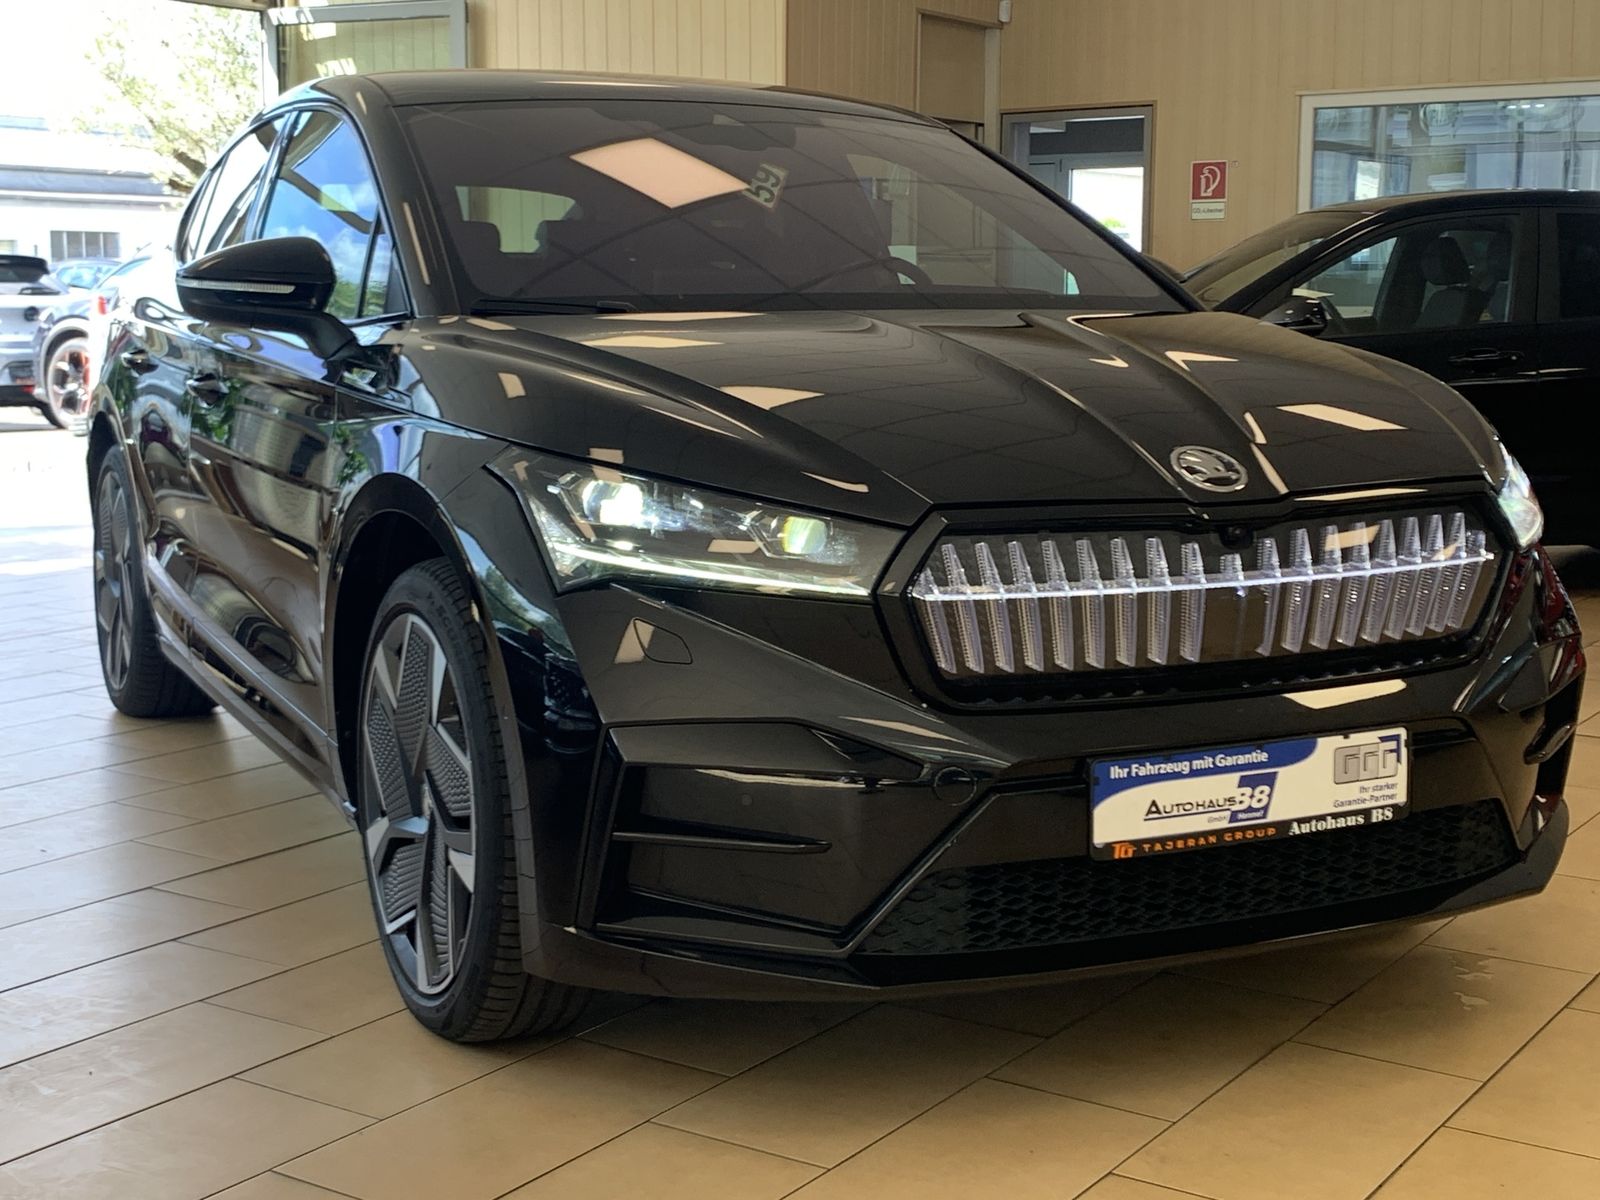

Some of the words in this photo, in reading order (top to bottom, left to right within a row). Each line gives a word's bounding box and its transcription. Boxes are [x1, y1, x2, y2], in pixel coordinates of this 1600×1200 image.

[1109, 766, 1129, 779] Ihr
[1131, 761, 1190, 777] Fahrzeug
[1192, 756, 1213, 770] mit
[1215, 750, 1269, 766] Garantie
[1359, 785, 1370, 794] Ihr
[1371, 782, 1398, 792] starker
[1288, 814, 1365, 836] Autohaus
[1142, 835, 1217, 853] TAJERAN
[1223, 827, 1277, 842] GROUP
